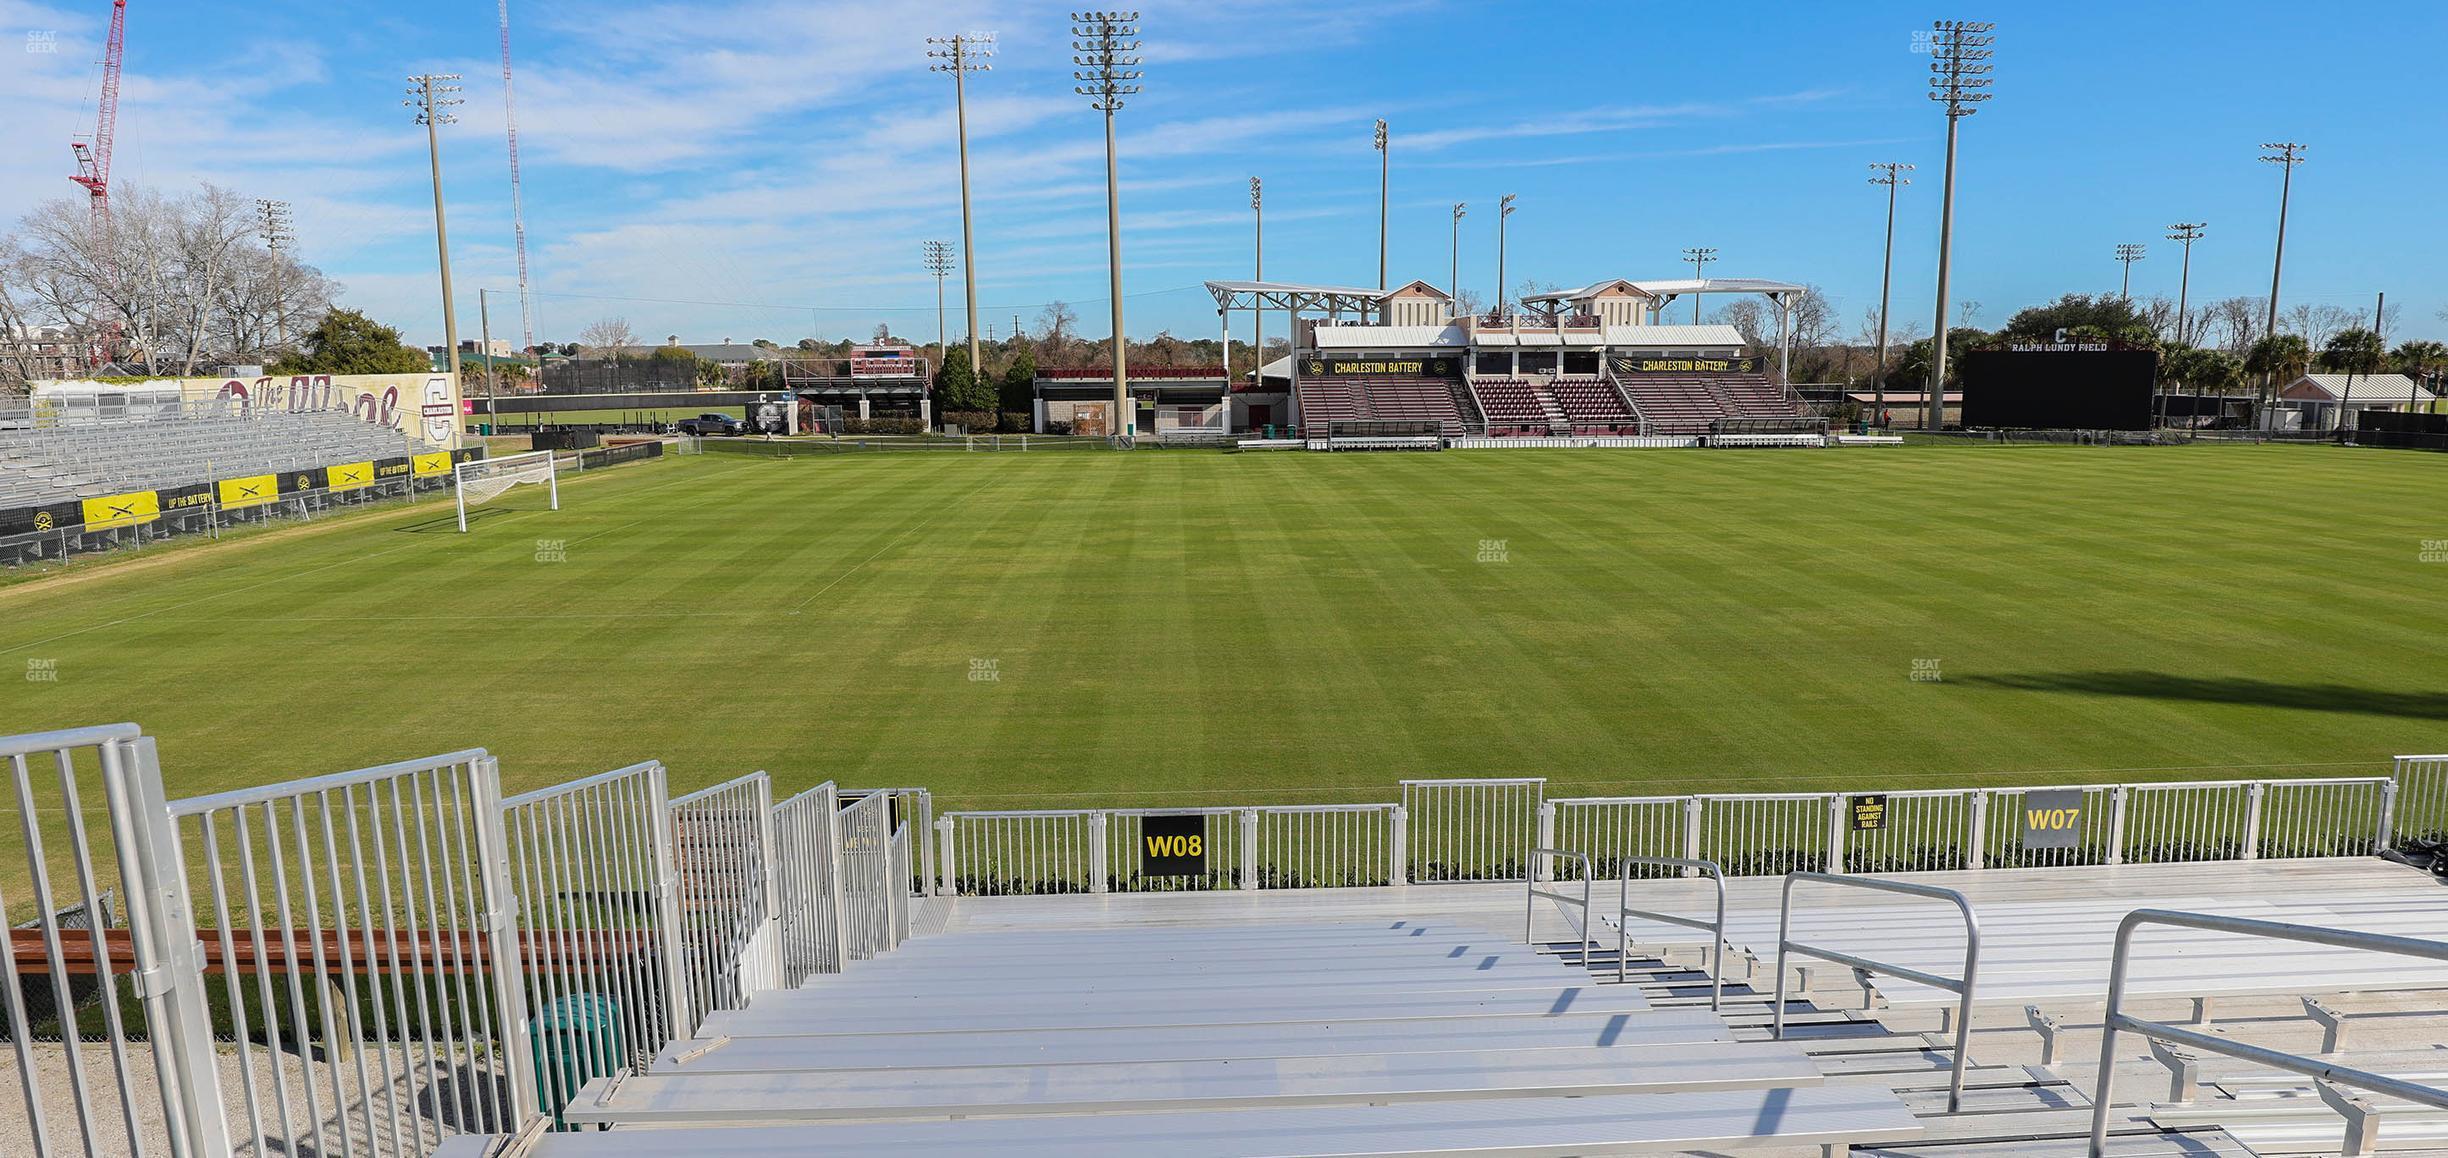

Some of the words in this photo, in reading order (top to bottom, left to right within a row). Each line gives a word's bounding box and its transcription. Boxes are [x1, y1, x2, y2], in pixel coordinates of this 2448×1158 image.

[2056, 328, 2067, 343] C
[2012, 344, 2042, 352] RALPH
[2045, 344, 2076, 352] LUNDY
[2079, 343, 2107, 352] FIELD
[1335, 362, 1386, 373] CHARLESTON
[1389, 362, 1422, 373] BATTERY
[1643, 360, 1692, 371] CHARLESTON
[1695, 360, 1728, 371] BATTERY
[168, 498, 176, 509] UP
[177, 496, 188, 507] THE
[1865, 797, 1875, 805] NO
[1856, 805, 1884, 814] STANDING
[1858, 812, 1882, 821] AGAINST
[2027, 809, 2080, 830] W07
[1861, 820, 1878, 828] RAILS
[1146, 834, 1202, 858] W08
